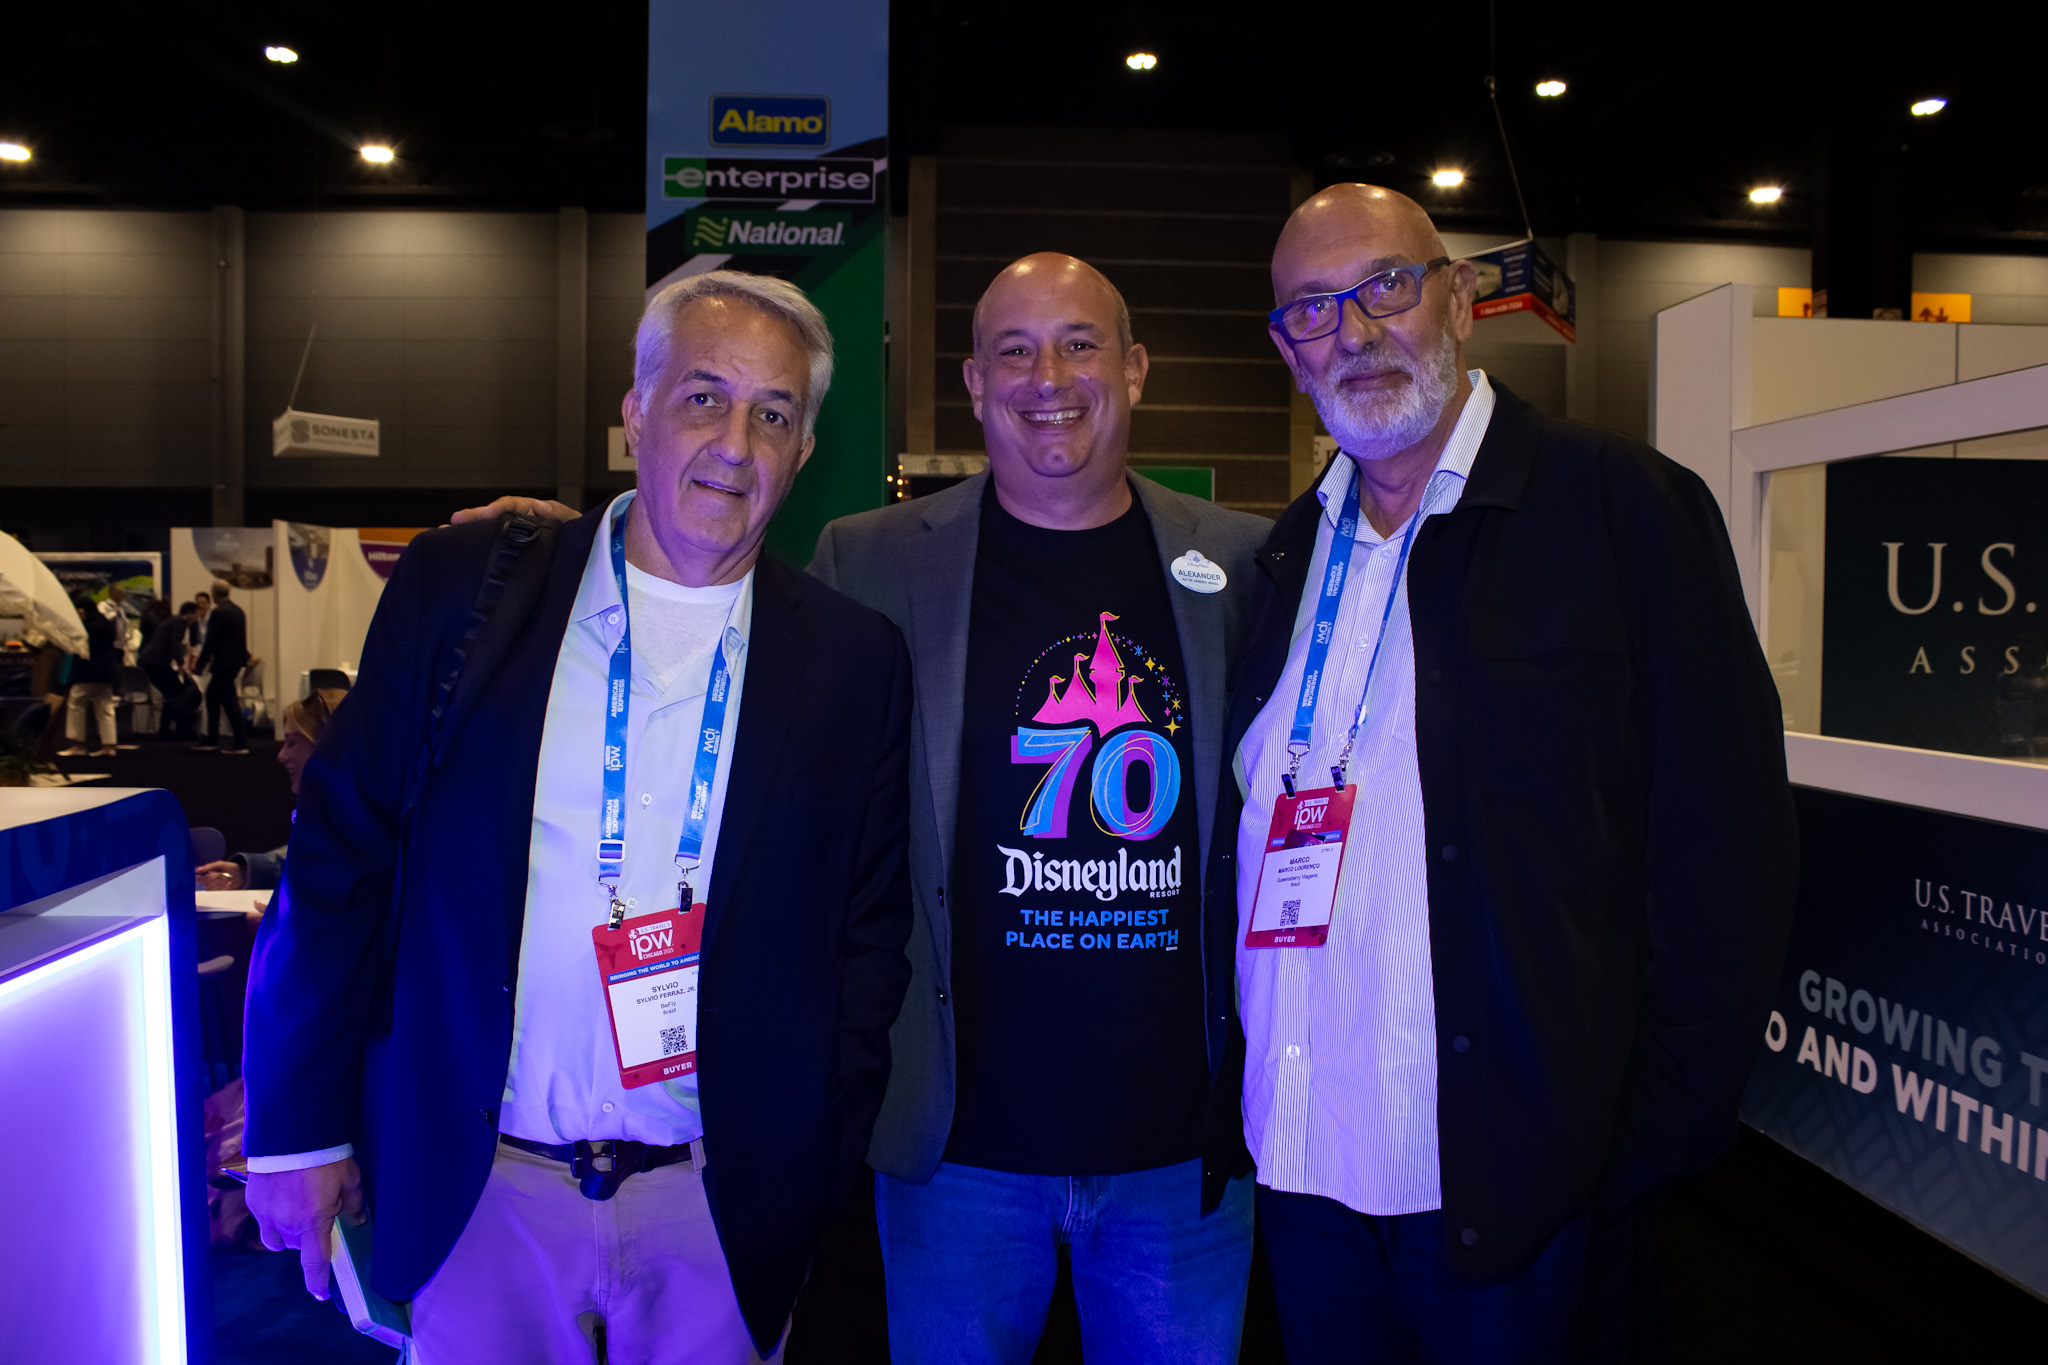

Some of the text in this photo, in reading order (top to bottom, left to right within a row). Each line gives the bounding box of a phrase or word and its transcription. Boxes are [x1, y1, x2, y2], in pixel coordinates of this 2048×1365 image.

[718, 109, 823, 133] Alamo
[676, 166, 871, 194] enterprise
[728, 220, 844, 245] National
[311, 424, 375, 440] SONESTA
[1178, 569, 1221, 582] ALEXANDER
[1326, 565, 1337, 597] EXPRESS
[1332, 561, 1345, 597] AMERICAN
[1881, 542, 2036, 615] U.S.
[1316, 621, 1329, 645] ipw
[611, 679, 619, 718] AMERICAN
[711, 670, 722, 703] EXPRESS
[703, 728, 716, 754] ipw
[611, 746, 624, 771] ipw
[1011, 726, 1181, 841] 70
[691, 785, 702, 820] EXPRESS
[697, 780, 709, 820] AMERICAN
[605, 799, 613, 838] AMERICAN
[612, 799, 620, 834] EXPRESS
[1294, 805, 1328, 830] ipw
[997, 844, 1182, 901] Disneyland
[1290, 857, 1310, 865] MARCO
[1295, 863, 1320, 872] LOURENÇO
[1149, 889, 1180, 898] RESORT
[1020, 908, 1169, 927] THE HAPPIEST
[1915, 878, 2048, 942] U.S. TRAVE
[650, 922, 671, 931] TRAVEL'S
[1006, 929, 1179, 949] PLACE ON EARTH
[629, 929, 674, 961] ipw
[1921, 919, 2047, 965] ASSOCIATIO
[643, 951, 664, 960] CHICAGO
[609, 970, 637, 981] BRINGING
[650, 961, 671, 972] WORLD
[636, 995, 659, 1005] SYLVIO
[652, 982, 679, 993] SYLVIO
[661, 1001, 676, 1009] BeFly
[1800, 969, 2002, 1088] GROWING
[663, 1061, 693, 1075] BUYER
[1797, 1026, 1878, 1094] AND
